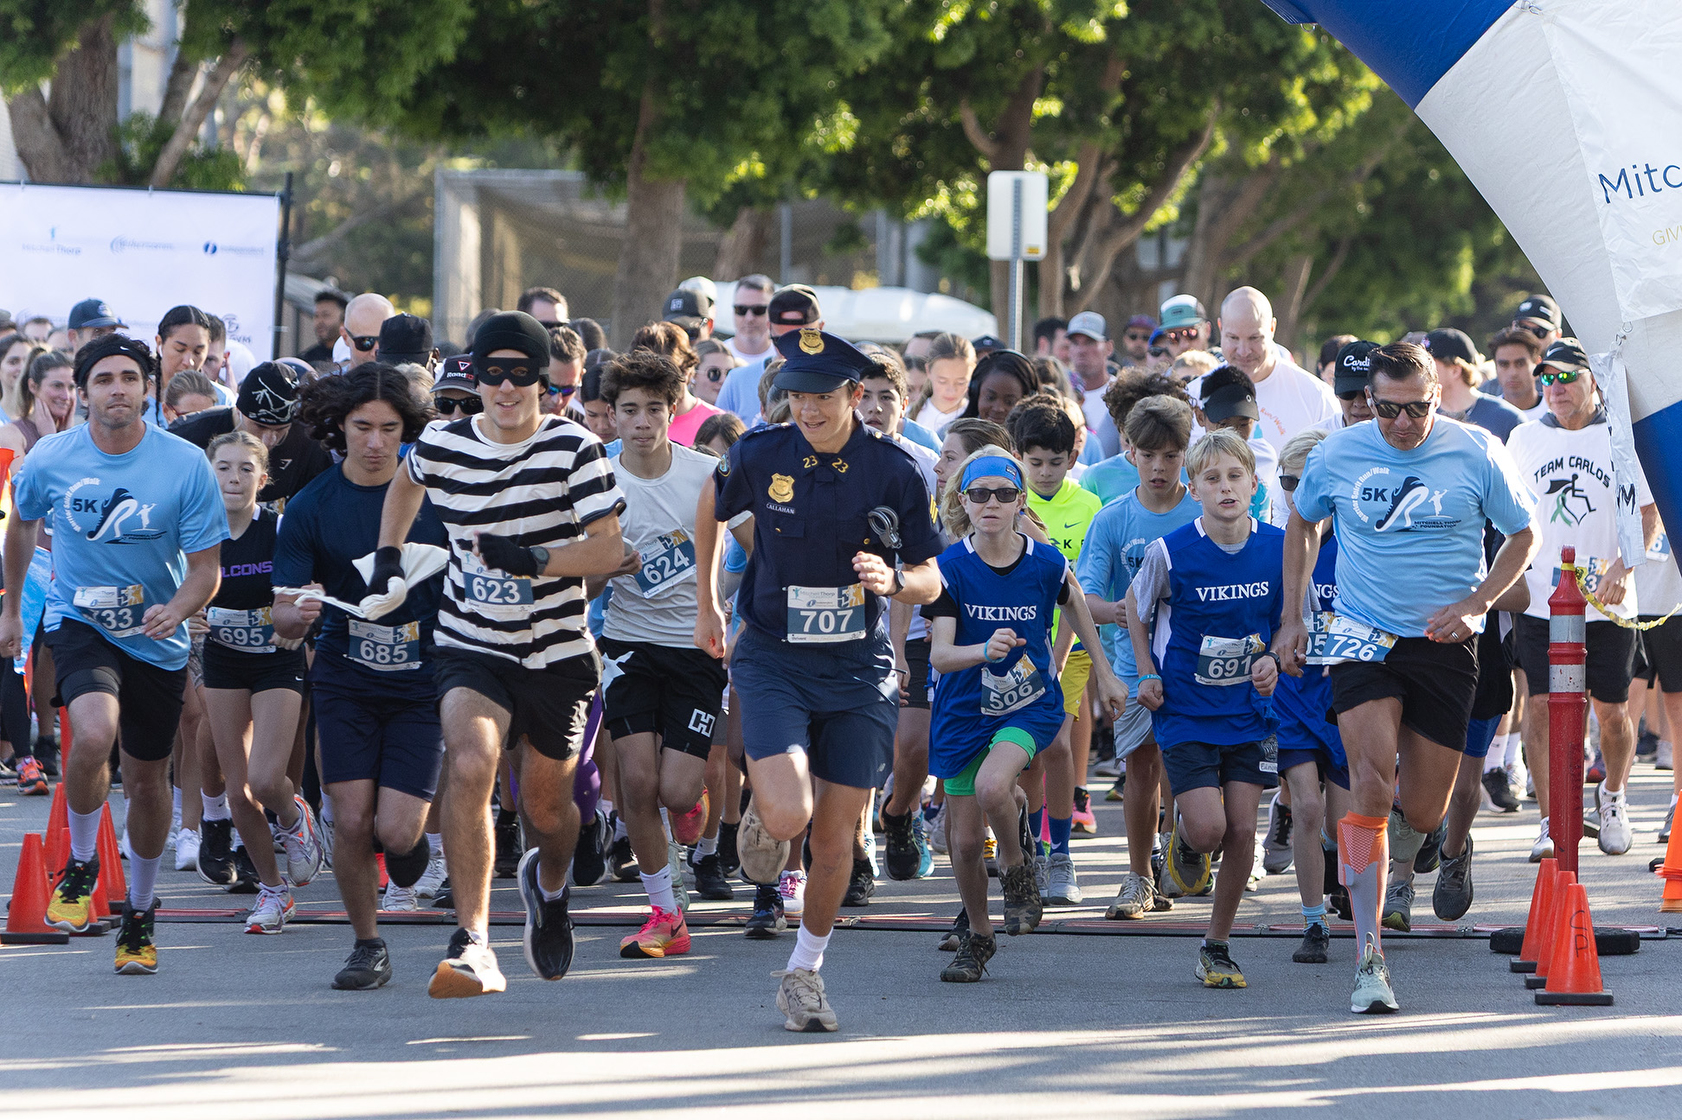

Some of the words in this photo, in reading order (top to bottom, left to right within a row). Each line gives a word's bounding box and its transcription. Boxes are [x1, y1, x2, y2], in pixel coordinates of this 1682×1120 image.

[1597, 163, 1682, 204] Mitc
[1652, 225, 1682, 246] GIV
[802, 455, 818, 469] 23
[831, 457, 849, 473] 23
[1533, 456, 1564, 484] TEAM
[1568, 455, 1611, 489] CARLOS
[1361, 486, 1388, 502] 5K
[72, 498, 98, 513] 5K
[766, 502, 796, 515] CALLAHAN
[221, 561, 273, 578] LCONS
[643, 547, 690, 585] 624
[472, 577, 521, 604] 623
[1195, 581, 1269, 602] VIKINGS
[800, 609, 854, 633] 707
[964, 603, 1037, 621] VIKINGS
[218, 627, 265, 646] 695
[360, 640, 408, 664] 685
[1330, 635, 1378, 661] 726
[1207, 655, 1253, 679] 691
[989, 681, 1033, 710] 506
